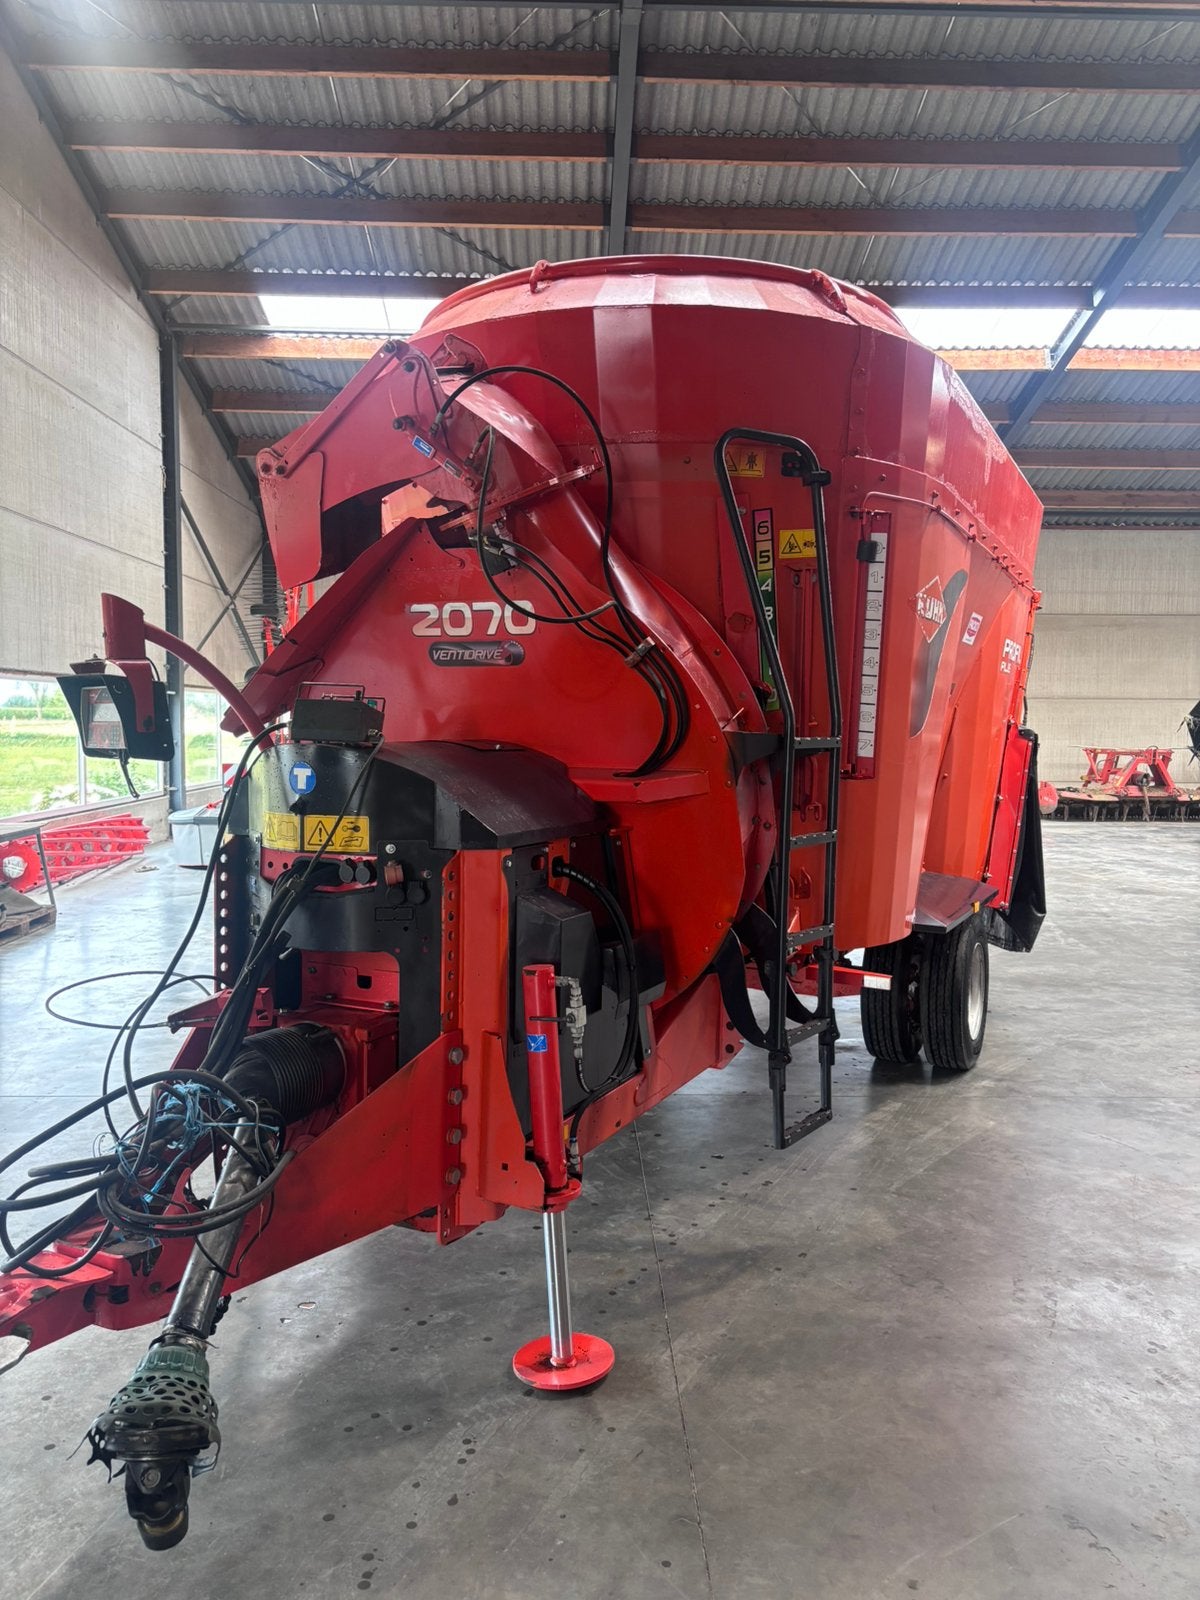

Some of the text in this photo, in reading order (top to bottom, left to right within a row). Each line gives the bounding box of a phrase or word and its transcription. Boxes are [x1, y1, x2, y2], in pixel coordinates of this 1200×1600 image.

[757, 520, 769, 535] 6
[759, 549, 771, 564] 5
[870, 571, 879, 583] 1
[760, 578, 772, 592] 4
[866, 600, 880, 612] 2
[410, 600, 537, 637] 2070
[864, 629, 877, 640] 3
[431, 648, 504, 661] VENTIDRIVE
[862, 656, 875, 668] 4
[862, 684, 874, 697] 5
[860, 711, 873, 723] 6
[859, 739, 871, 751] 7
[293, 767, 312, 789] T
